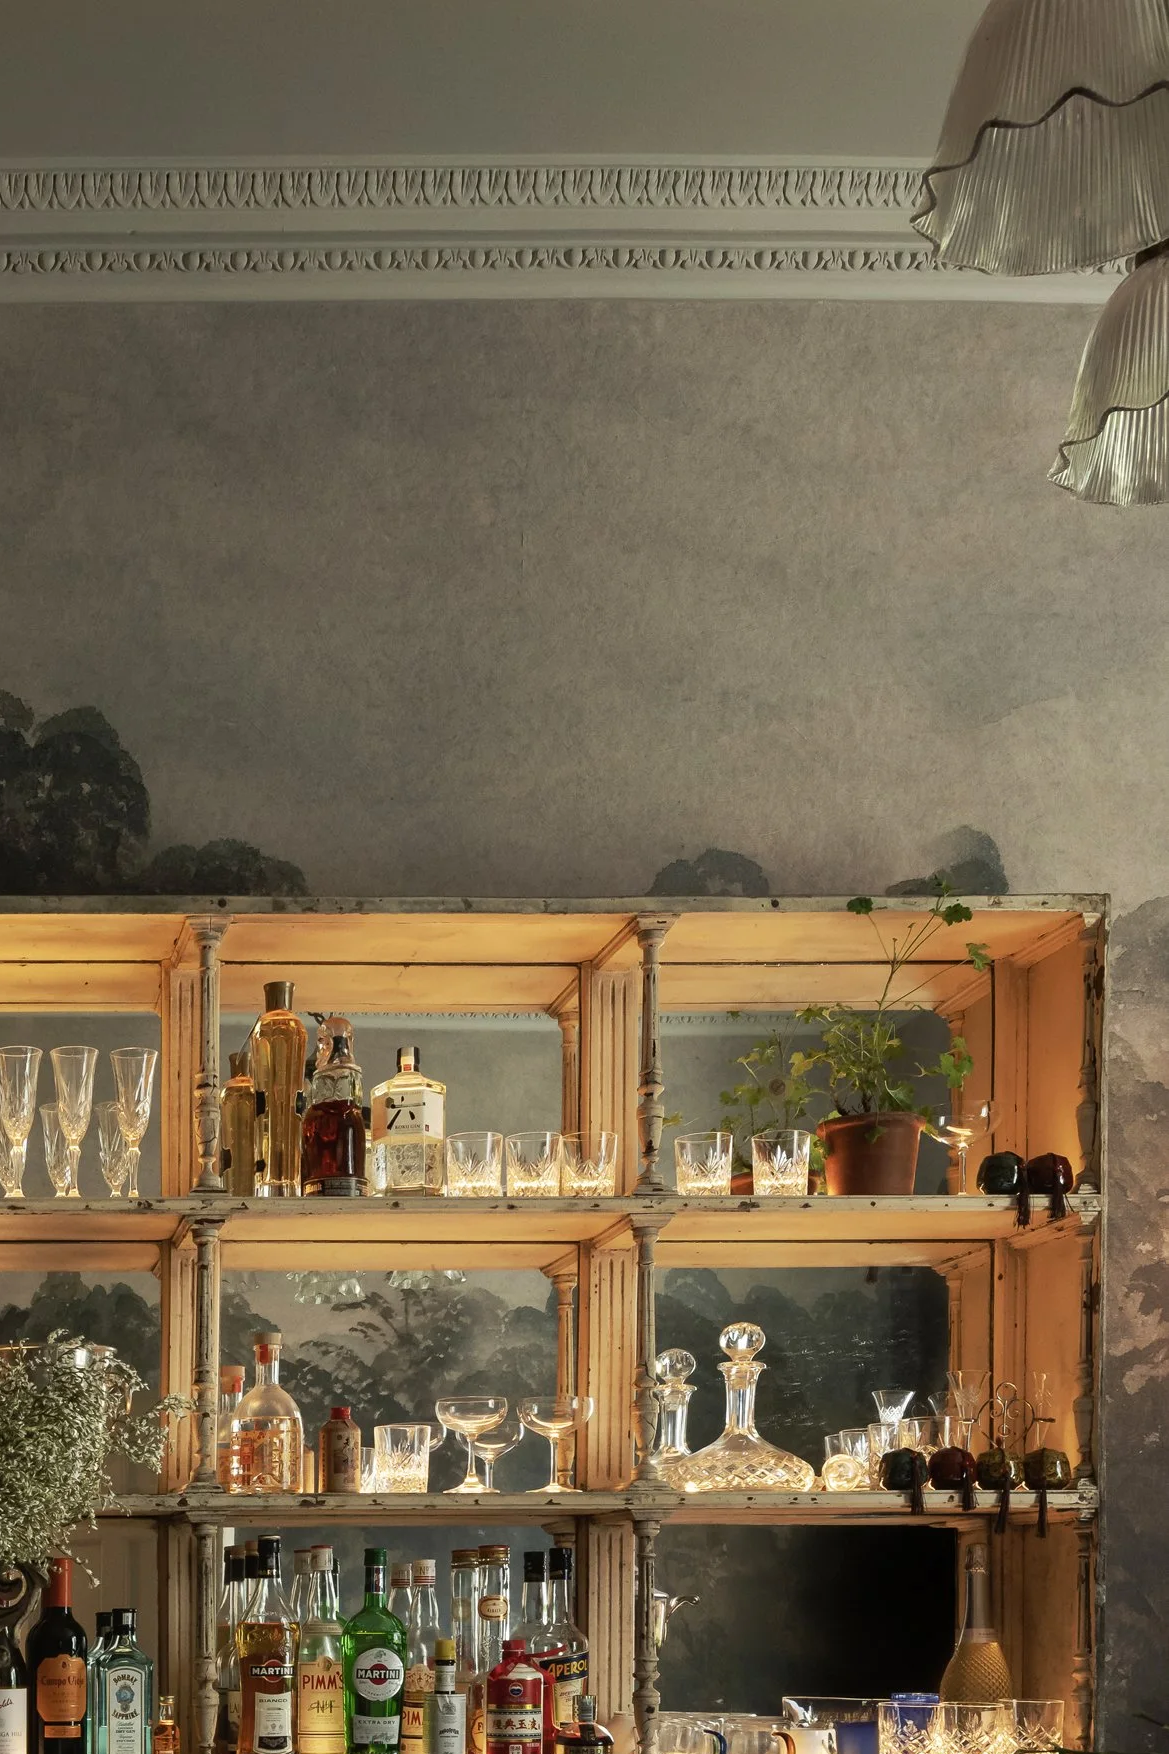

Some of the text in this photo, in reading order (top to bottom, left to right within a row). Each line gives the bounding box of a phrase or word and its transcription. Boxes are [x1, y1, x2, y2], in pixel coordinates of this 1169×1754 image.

[252, 1667, 293, 1675] MARTINI
[357, 1669, 399, 1679] MARTINI
[548, 1659, 588, 1678] APEROL
[42, 1675, 66, 1688] Campo
[112, 1674, 138, 1686] BOMBAY
[302, 1671, 344, 1690] PIMM'S
[111, 1709, 140, 1721] SAPPHIRE
